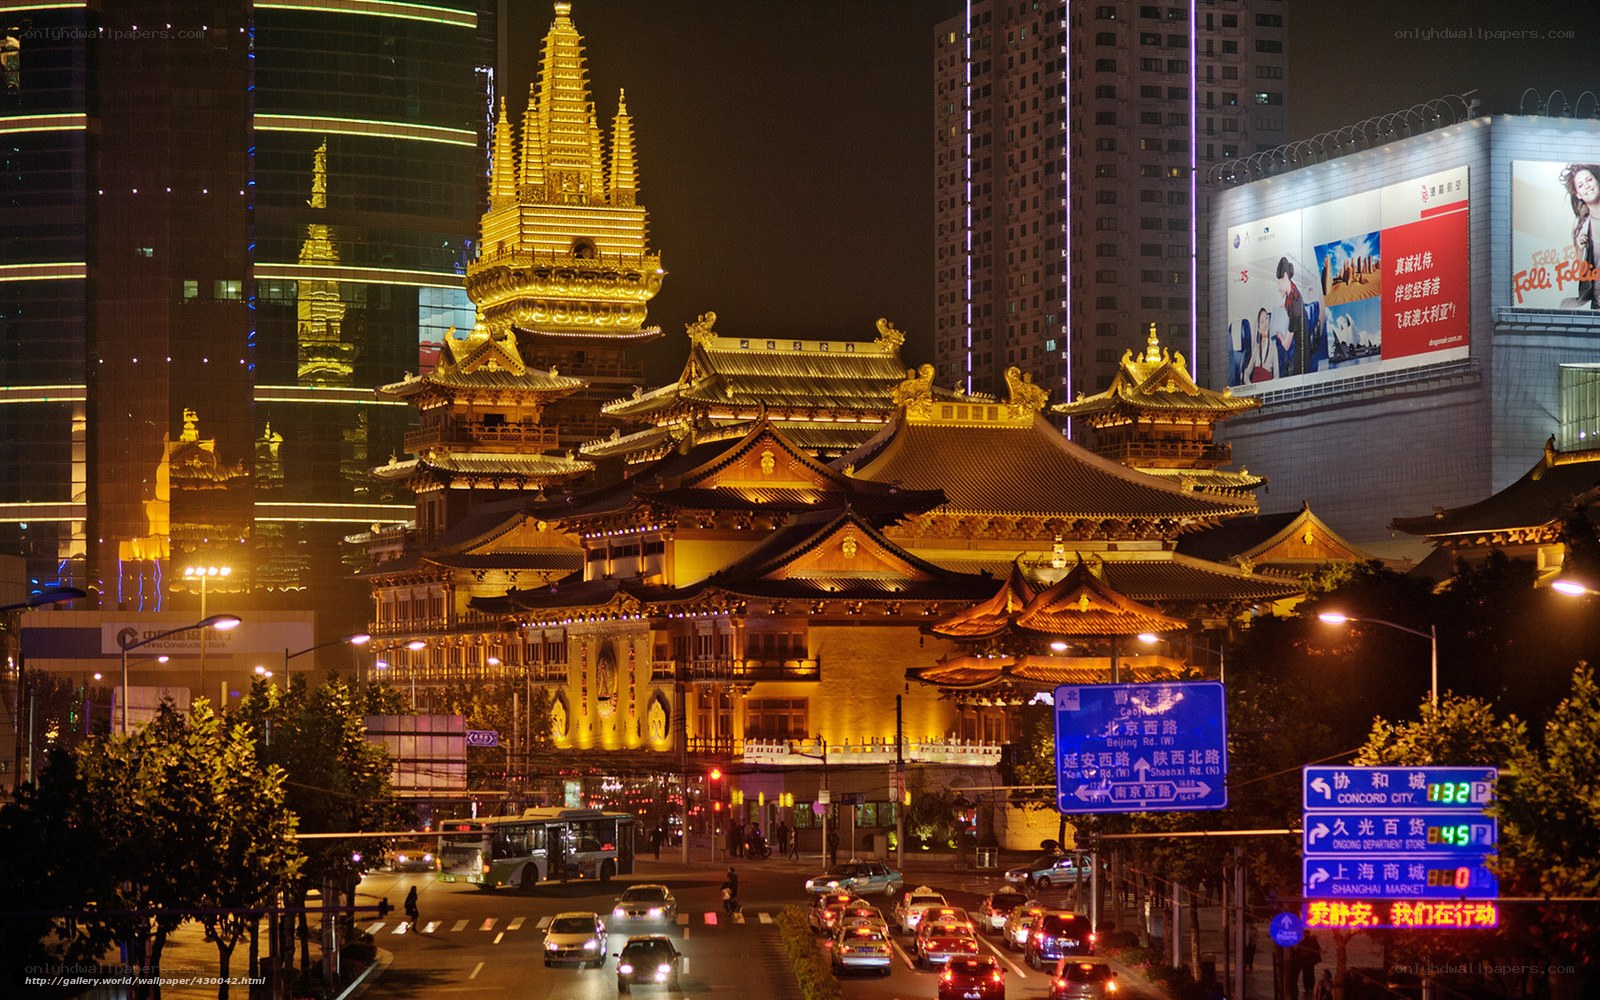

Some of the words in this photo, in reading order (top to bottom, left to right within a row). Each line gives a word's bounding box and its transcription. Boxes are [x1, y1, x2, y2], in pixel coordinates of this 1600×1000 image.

[1395, 277, 1440, 303] 伴您经香港
[1513, 267, 1552, 304] Folli
[1067, 690, 1078, 701] 北
[1105, 720, 1178, 736] 北京西路
[1107, 739, 1137, 748] Beijing
[1143, 738, 1157, 746] Rd.
[1161, 738, 1175, 746] (W)
[1064, 753, 1131, 769] 延安西路
[1153, 750, 1220, 766] 陕西北路
[1100, 769, 1114, 778] Rd.
[1116, 769, 1130, 778] (W)
[1150, 767, 1185, 777] Shaanxi
[1190, 767, 1203, 776] Rd.
[1206, 767, 1220, 776] (N)
[1333, 772, 1427, 789] 协和城
[1115, 785, 1171, 799] 南京西路
[1337, 793, 1387, 804] CONCORD
[1392, 793, 1414, 803] CITY
[1432, 782, 1470, 804] 132
[1476, 784, 1487, 801] P
[1332, 818, 1425, 836] 久光百货
[1442, 824, 1469, 847] 45
[1363, 839, 1402, 849] DEPARTMENT
[1405, 839, 1426, 849] STORE
[1332, 863, 1425, 881] 上海商城
[1455, 867, 1470, 889] 0
[1332, 884, 1381, 894] SHANGHAI
[1386, 884, 1424, 894] MARKET
